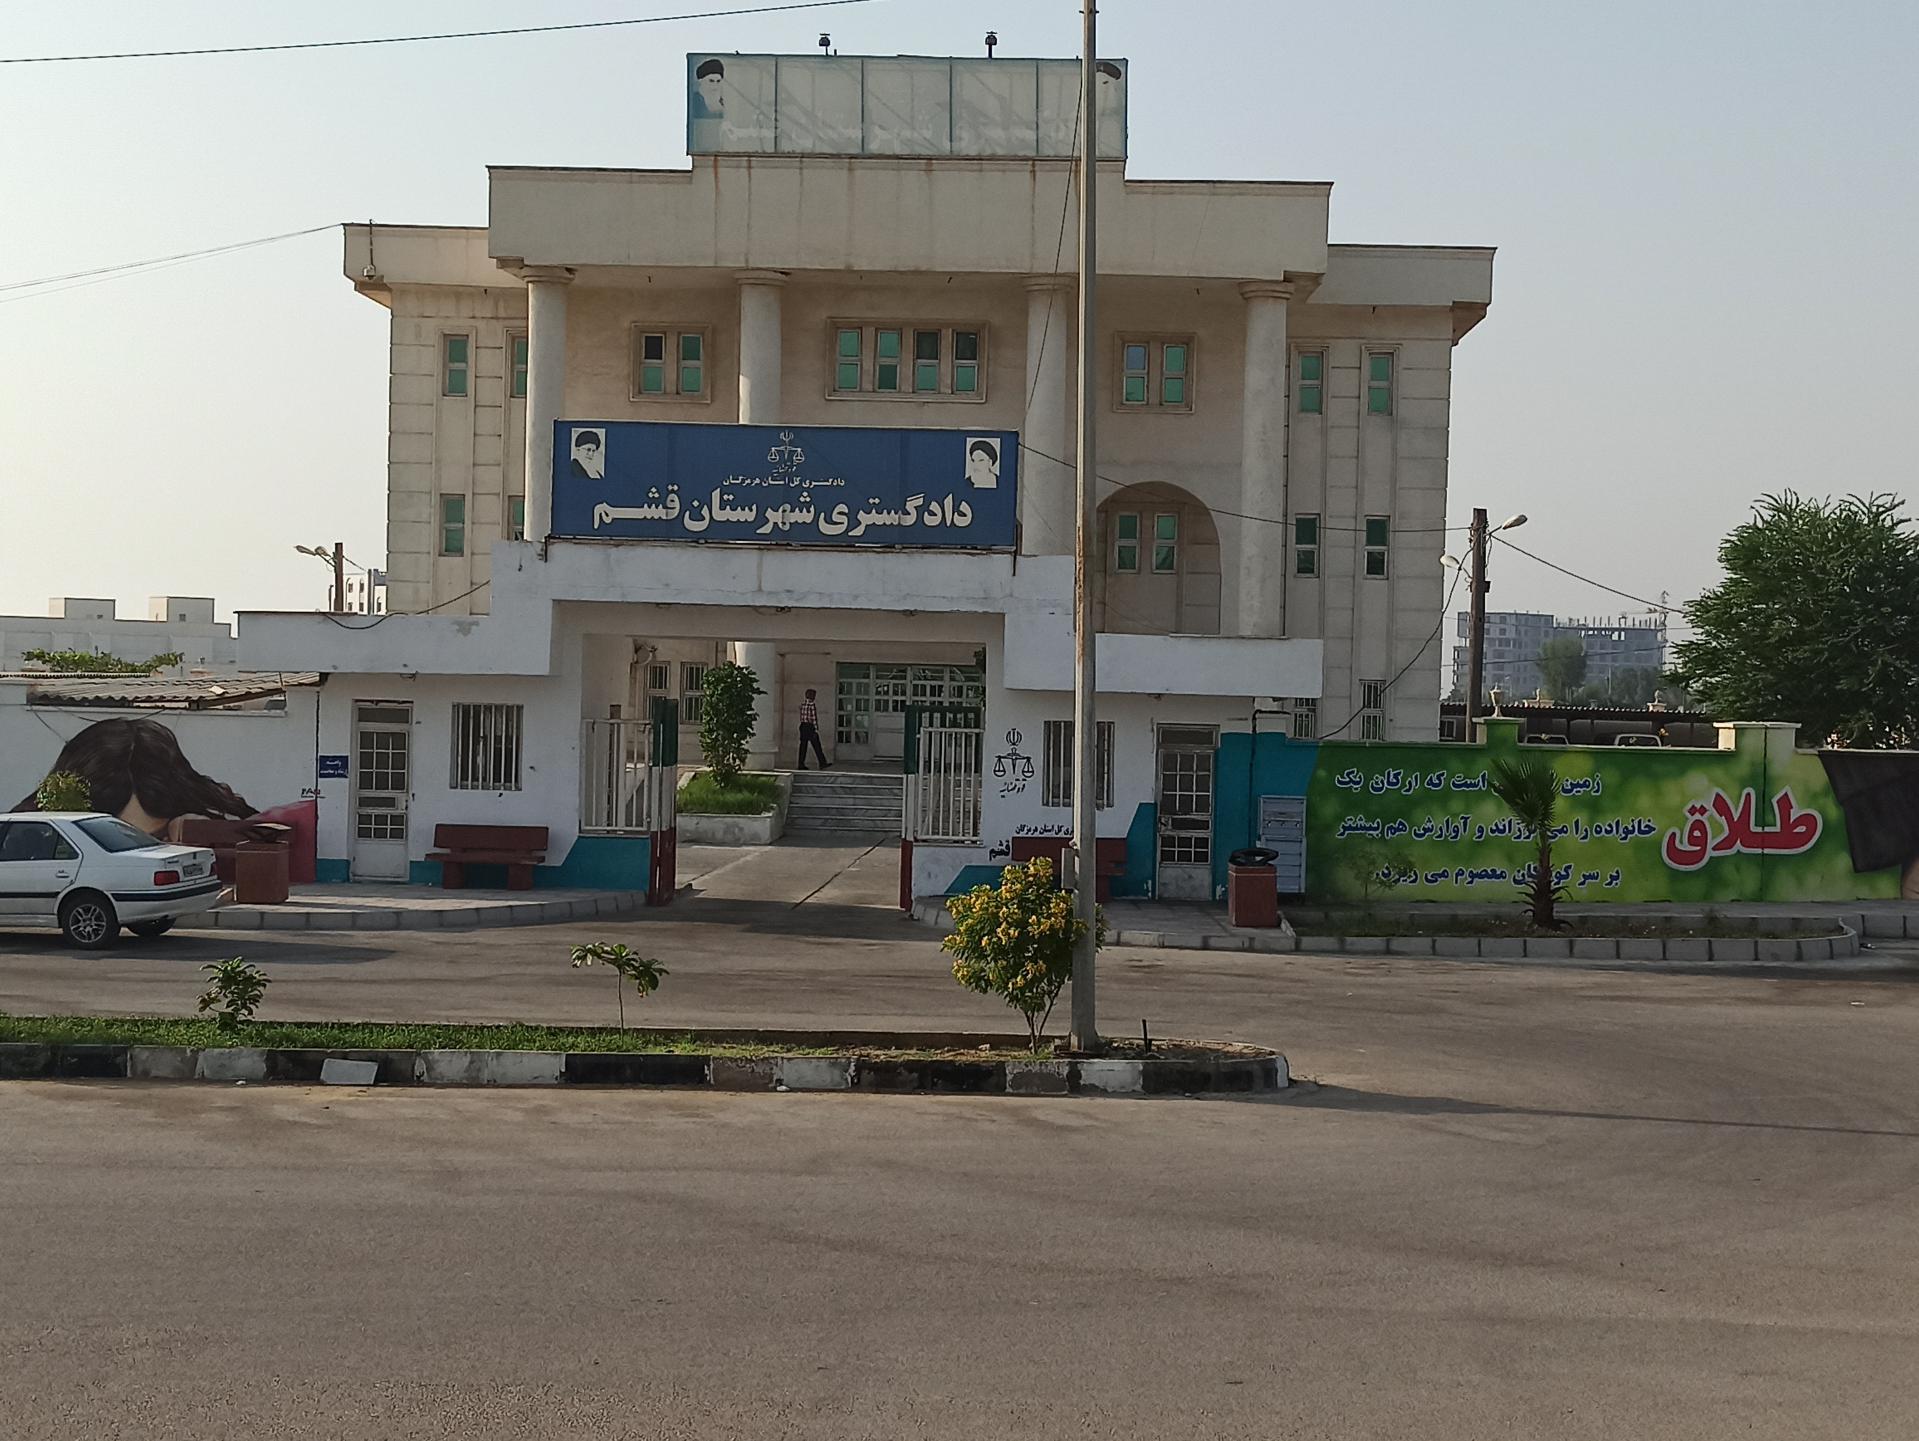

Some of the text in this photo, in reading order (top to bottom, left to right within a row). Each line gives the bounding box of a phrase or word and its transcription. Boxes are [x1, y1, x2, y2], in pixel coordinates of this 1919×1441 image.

[593, 484, 973, 536] دادگستری شهرستان قشم
[1335, 768, 1364, 792] یک
[1369, 768, 1420, 794] ارکان
[1425, 771, 1447, 790] که
[1450, 770, 1488, 791] است
[1560, 773, 1602, 796] زمین
[1336, 814, 1382, 838] بیشتر
[1384, 818, 1409, 839] هم
[1412, 814, 1471, 841] آوارش
[1473, 823, 1485, 841] و
[1547, 823, 1570, 841] می
[1573, 817, 1589, 842] را
[1593, 817, 1657, 842] خانواده
[1664, 787, 1821, 869] طلاق
[989, 839, 1011, 861] قشم
[1424, 868, 1450, 885] می
[1454, 867, 1508, 886] معصوم
[1512, 863, 1574, 887] کوان
[1576, 869, 1600, 887] سر
[1603, 867, 1621, 888] بر
